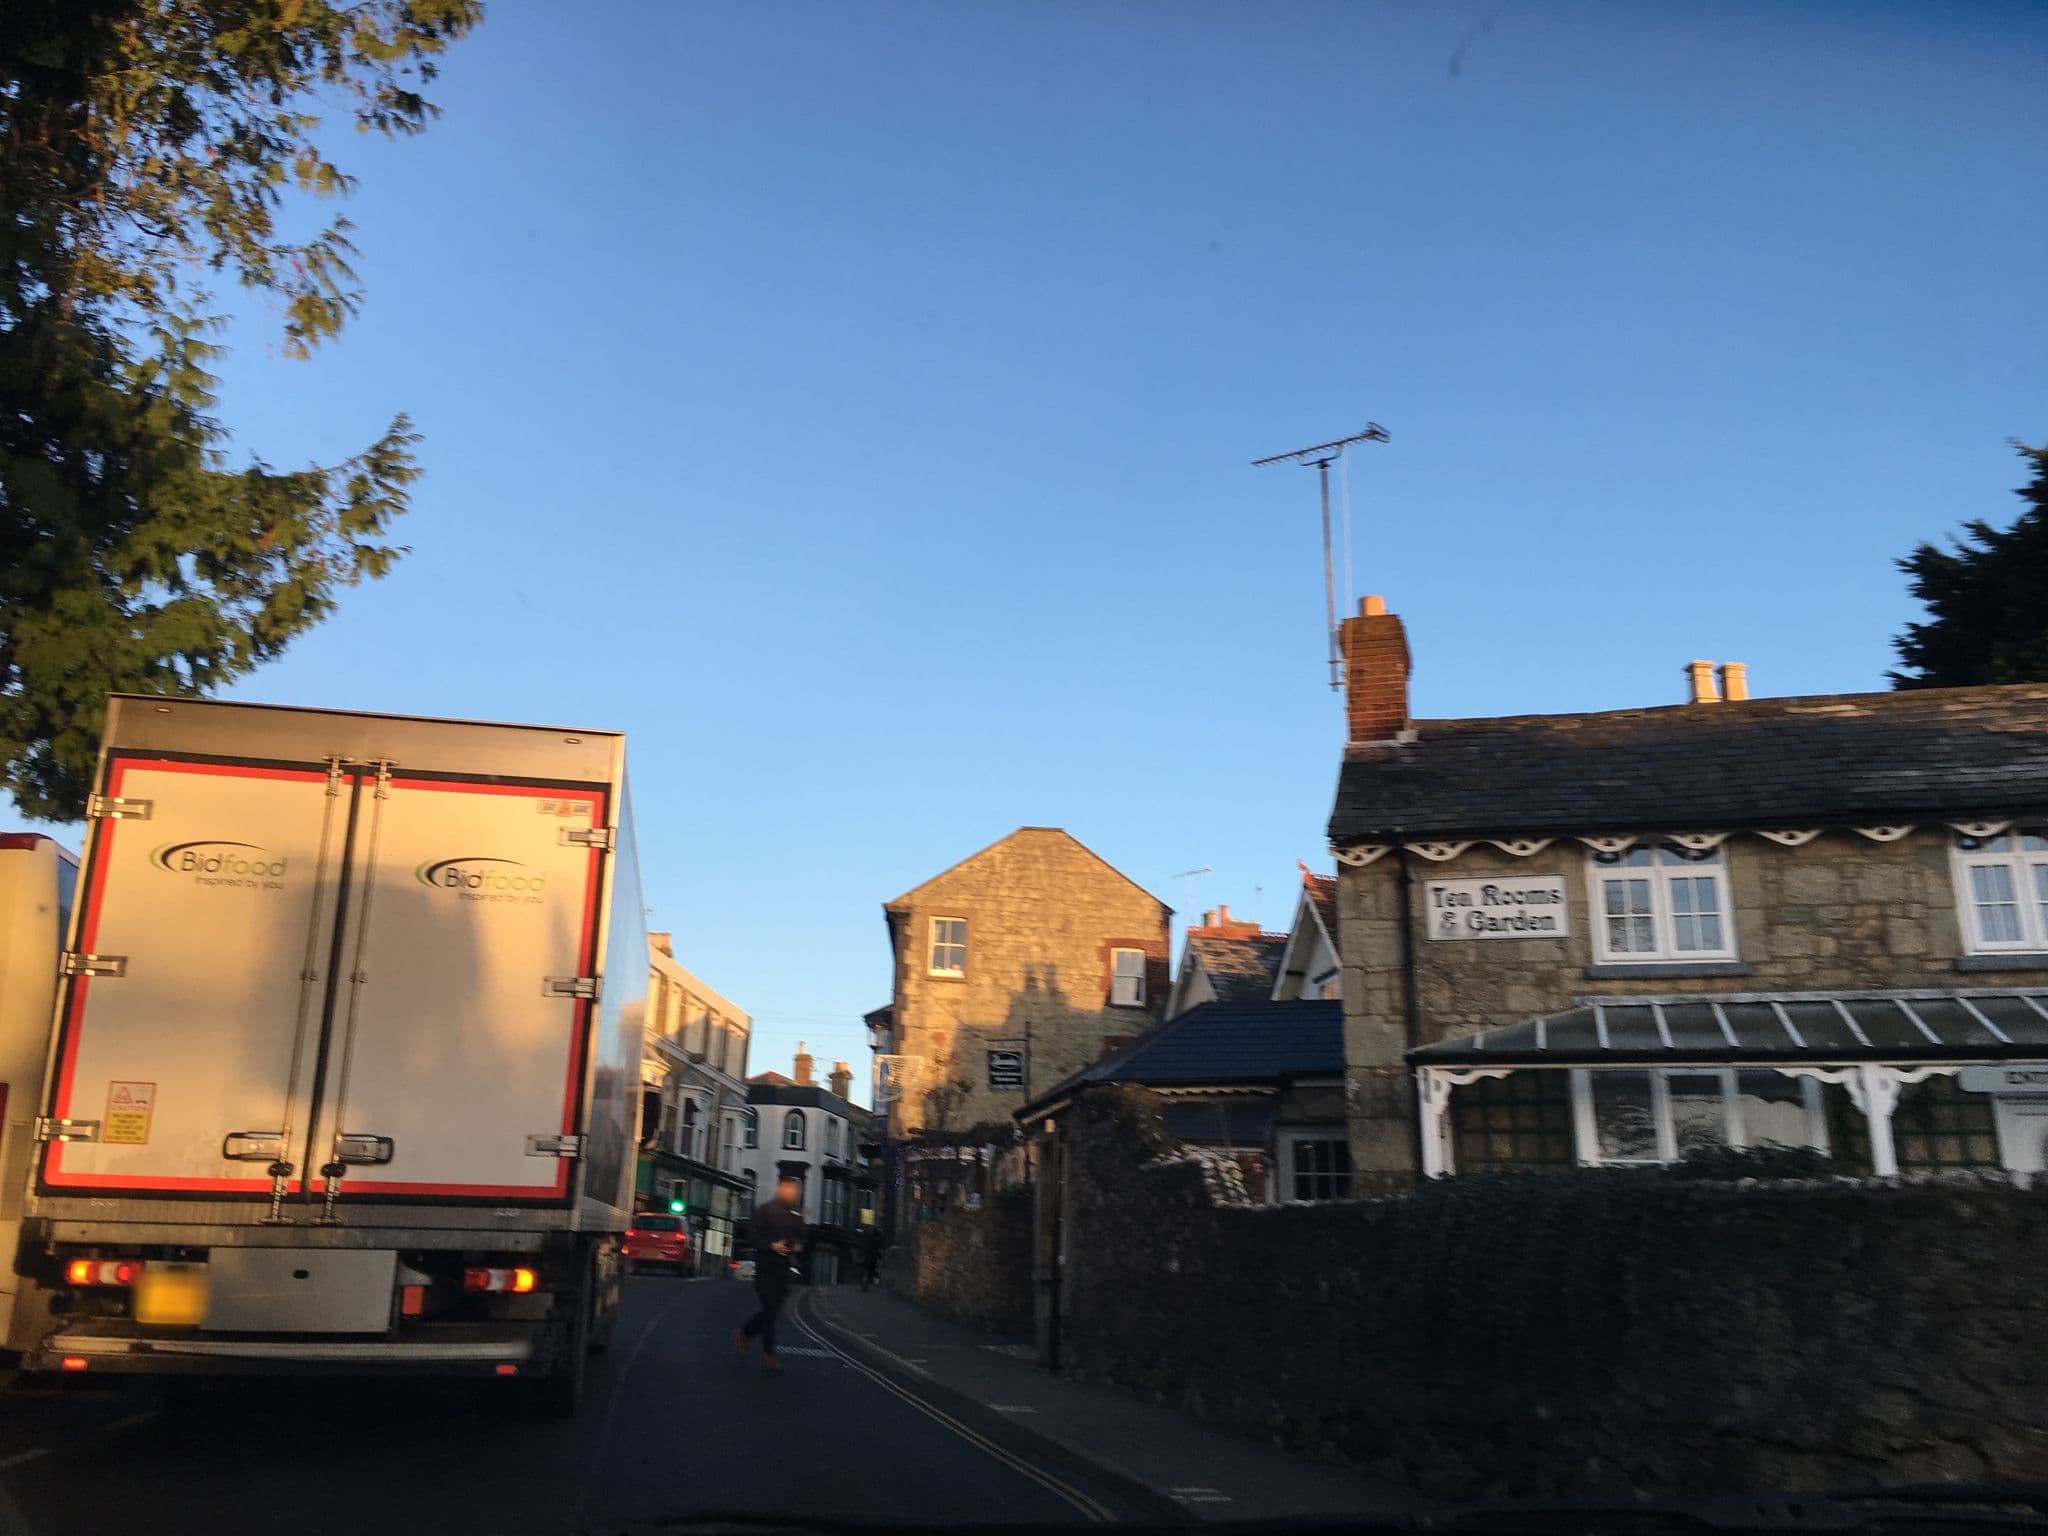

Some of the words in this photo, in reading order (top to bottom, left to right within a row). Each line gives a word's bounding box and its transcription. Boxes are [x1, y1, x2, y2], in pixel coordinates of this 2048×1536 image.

[181, 850, 288, 877] Bidfood
[445, 867, 545, 891] Bidfood
[1432, 886, 1473, 908] Tea
[1481, 884, 1563, 906] Rooms
[1440, 911, 1456, 928] &
[1466, 909, 1556, 932] Garden
